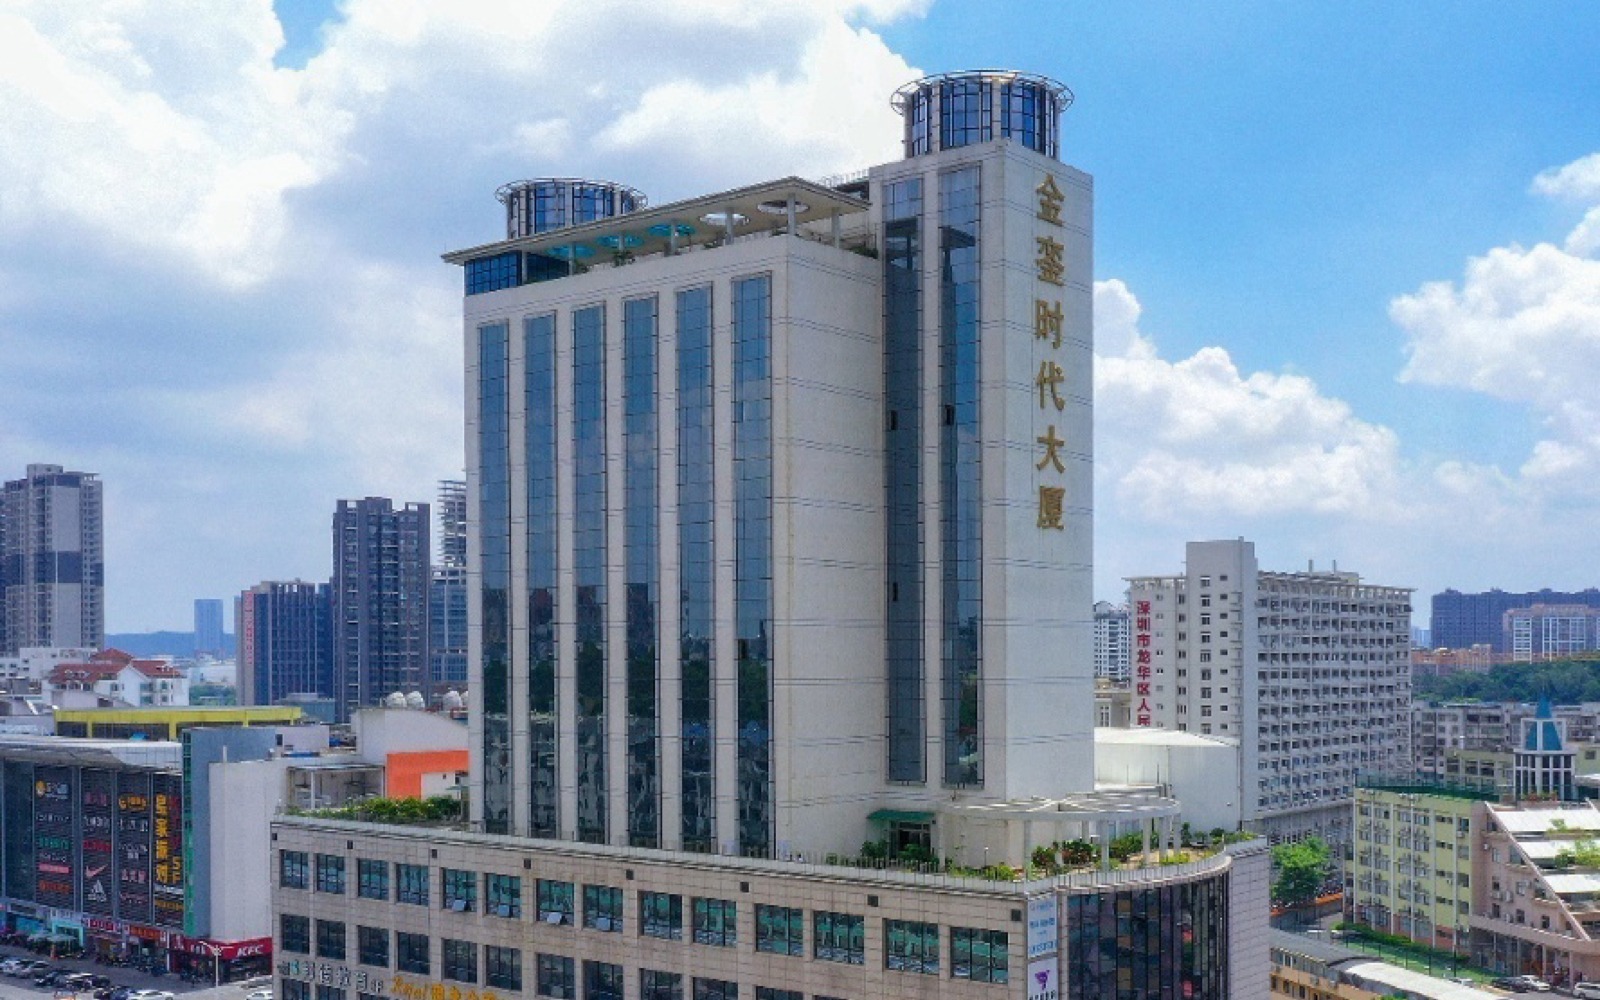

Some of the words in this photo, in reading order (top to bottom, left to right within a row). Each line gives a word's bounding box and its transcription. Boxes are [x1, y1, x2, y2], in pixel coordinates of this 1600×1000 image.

[1036, 173, 1065, 531] 金銮时代大厦
[1136, 600, 1151, 725] 深圳市龙华区人民
[236, 944, 263, 958] KFC
